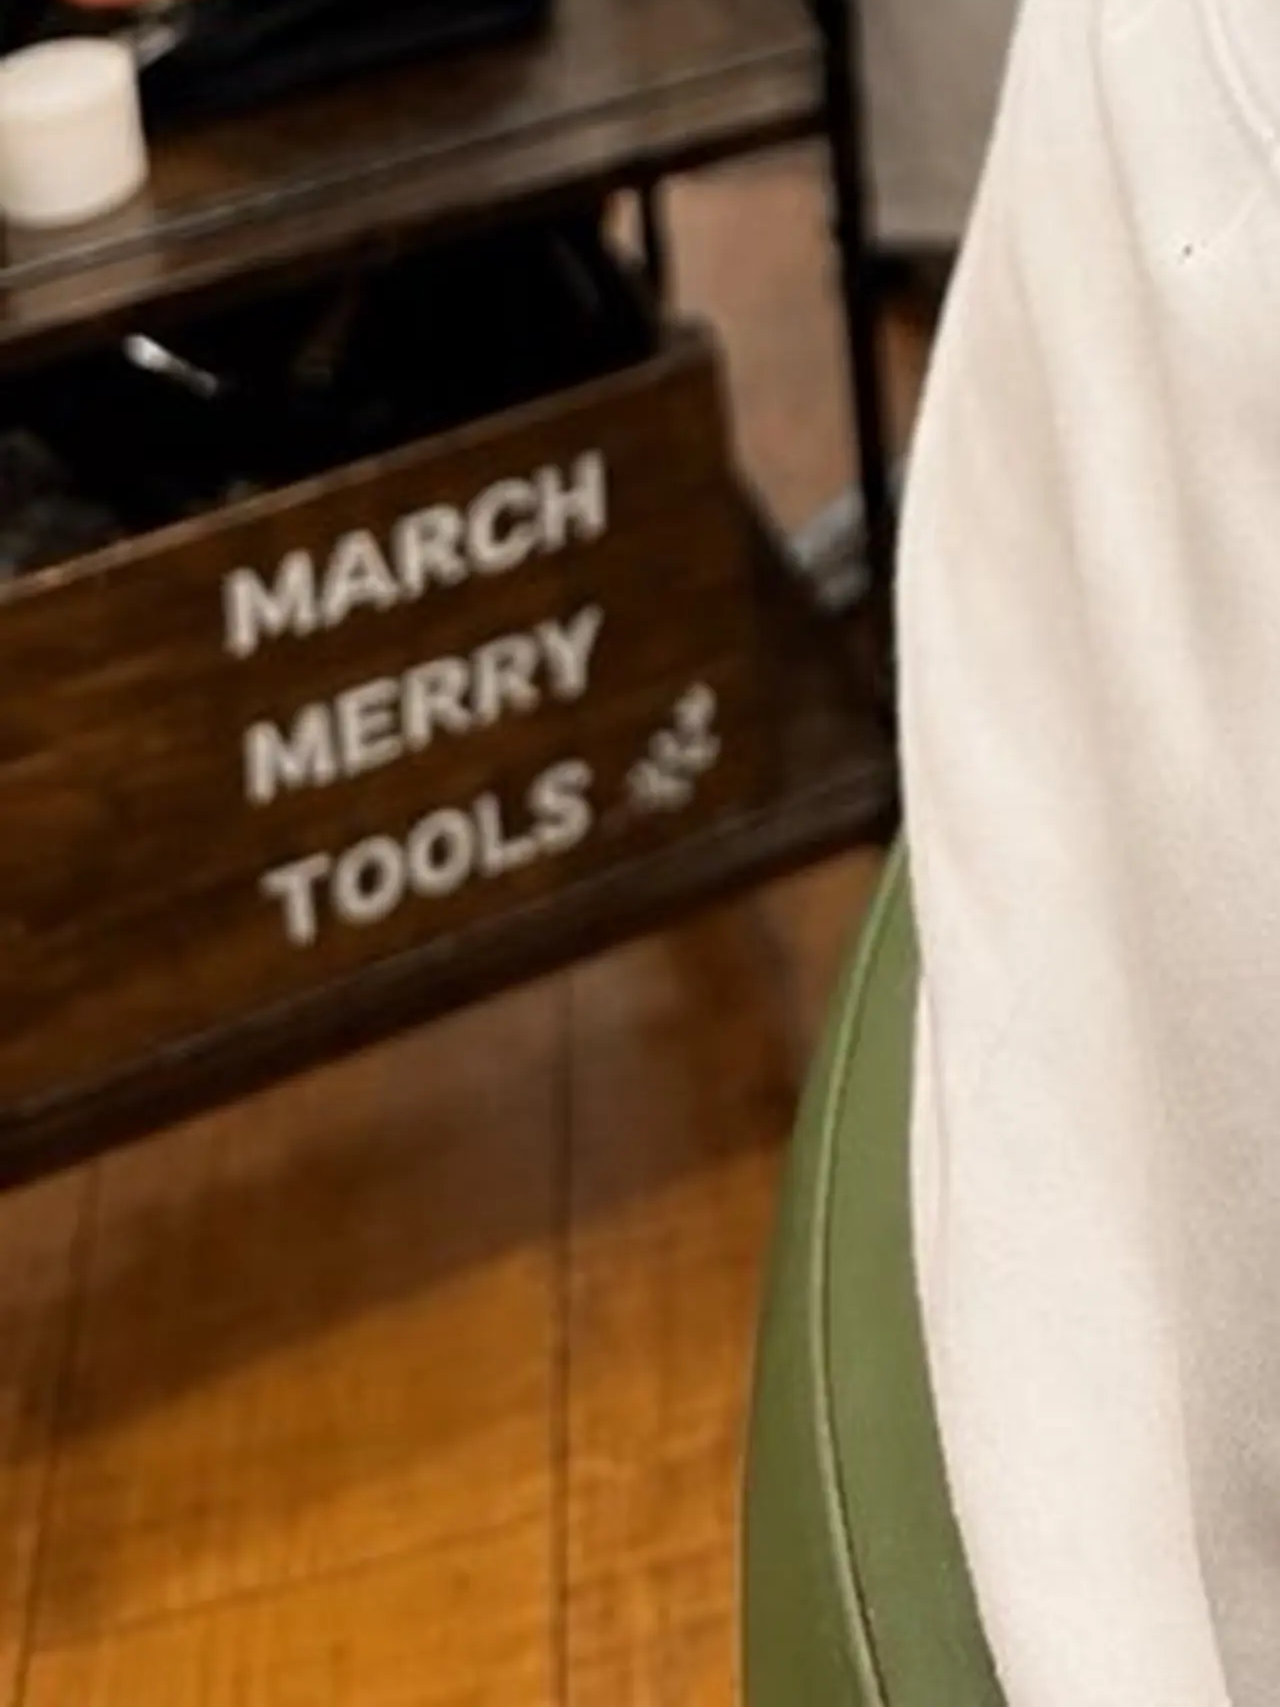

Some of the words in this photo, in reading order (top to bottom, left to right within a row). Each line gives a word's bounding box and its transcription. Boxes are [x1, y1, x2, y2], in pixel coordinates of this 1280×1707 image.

[224, 453, 606, 656] MARCH
[245, 608, 602, 802] MERRY
[263, 761, 591, 944] TOOLS
